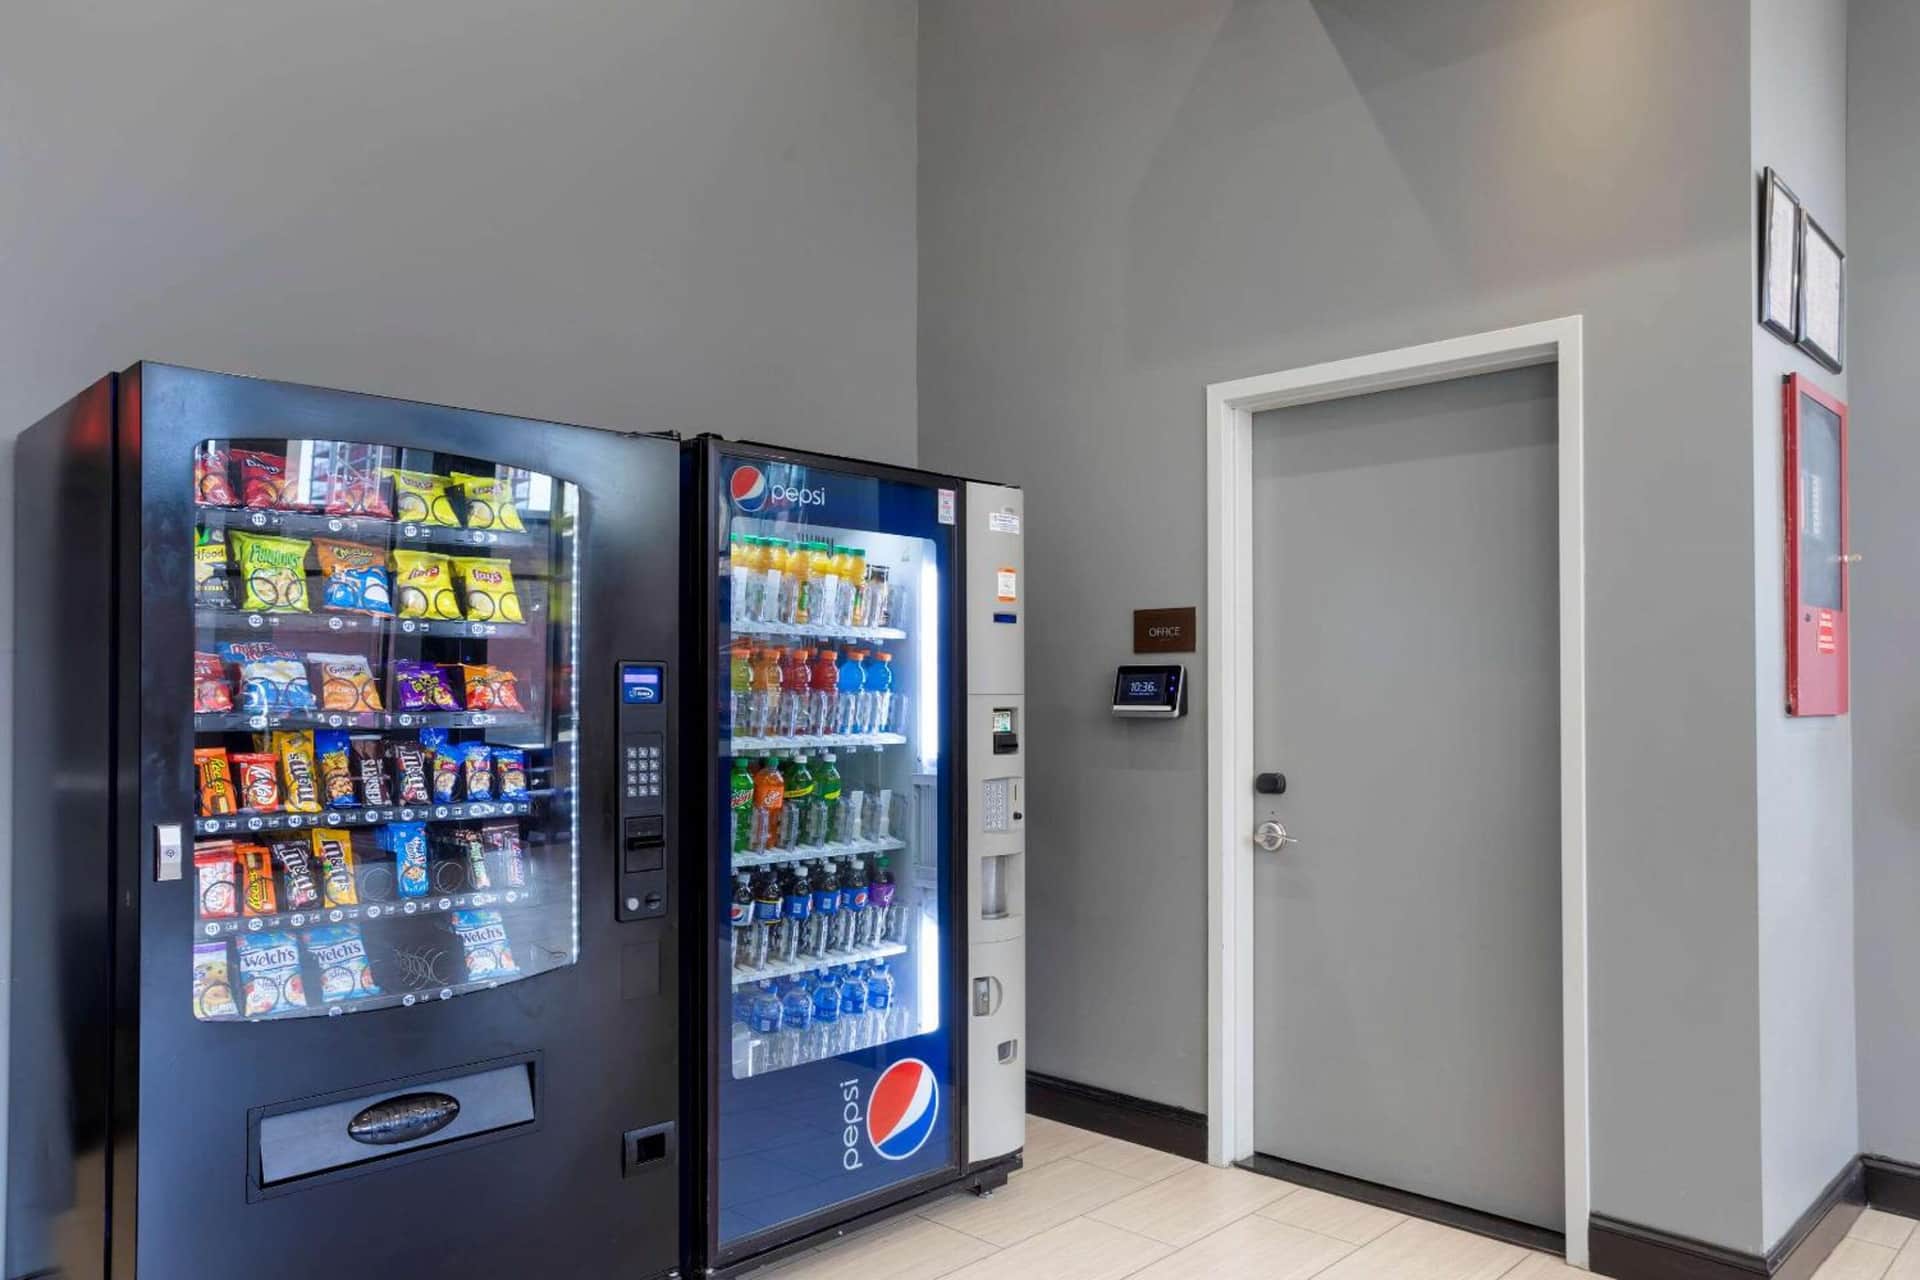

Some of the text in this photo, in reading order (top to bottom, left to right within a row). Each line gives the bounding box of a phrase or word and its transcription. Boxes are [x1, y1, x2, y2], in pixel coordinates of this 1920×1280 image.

[771, 485, 825, 506] pepsi
[1148, 626, 1182, 638] OFFICE
[1129, 681, 1156, 692] 10:36
[462, 927, 503, 943] Welch's
[244, 949, 296, 967] Welch's
[318, 941, 361, 962] Welch's
[840, 1079, 863, 1170] pepsi
